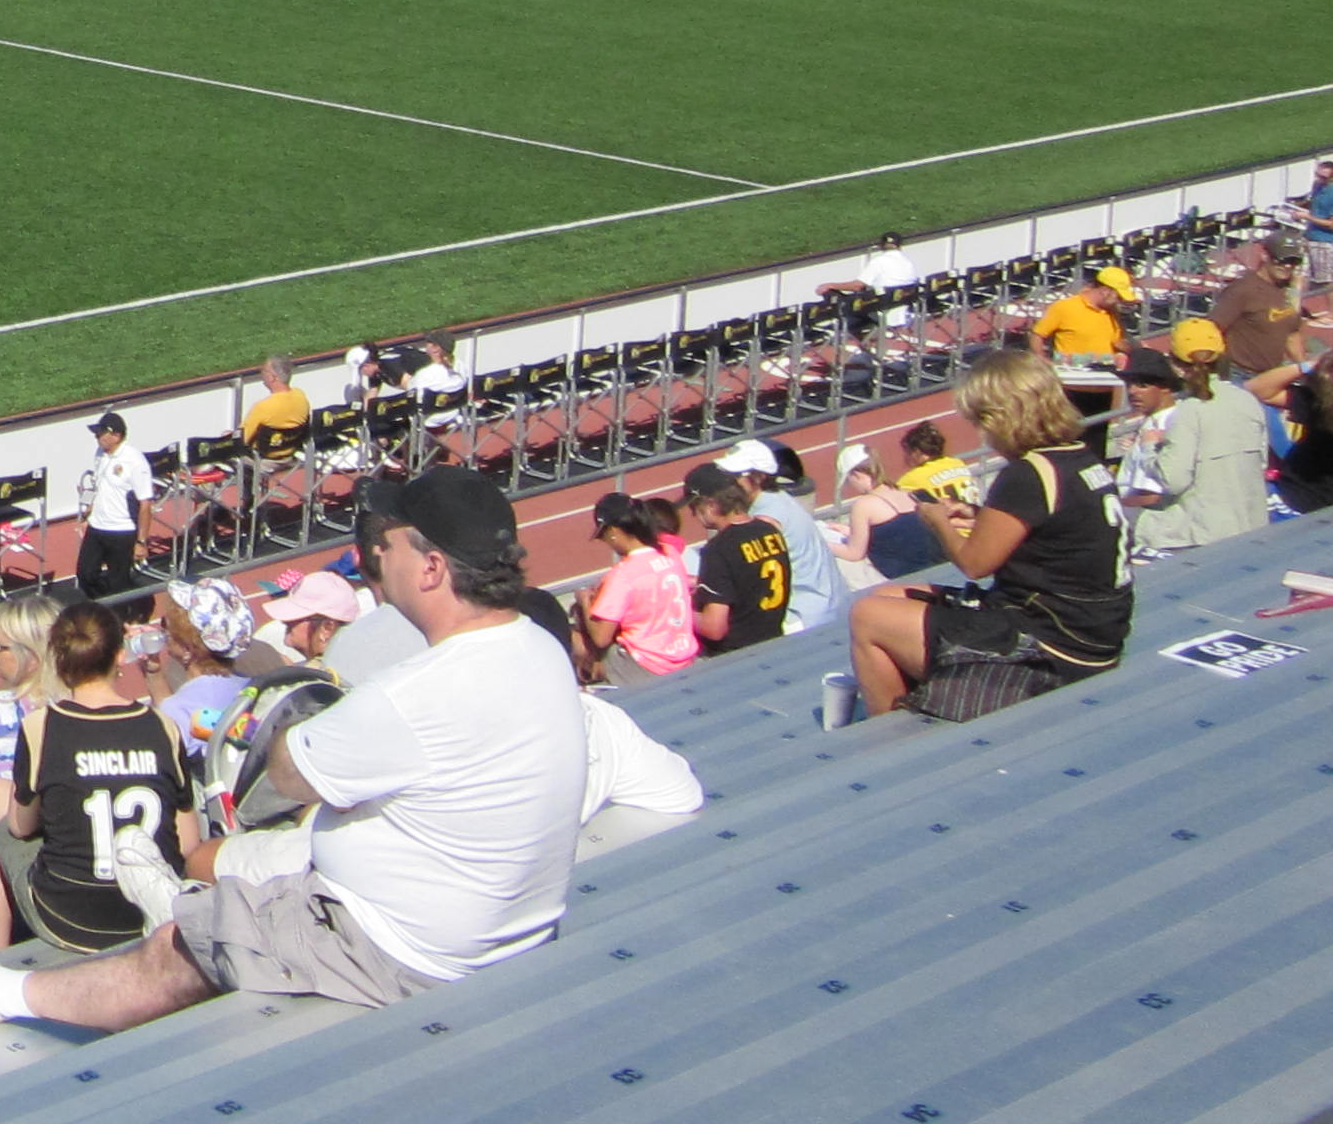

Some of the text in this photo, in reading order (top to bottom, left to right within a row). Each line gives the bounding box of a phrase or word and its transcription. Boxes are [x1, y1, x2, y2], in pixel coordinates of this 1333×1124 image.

[760, 559, 784, 611] 3
[662, 574, 687, 626] 3
[1197, 641, 1248, 657] GO
[75, 750, 158, 776] SINCLAIR
[609, 1067, 644, 1085] 33
